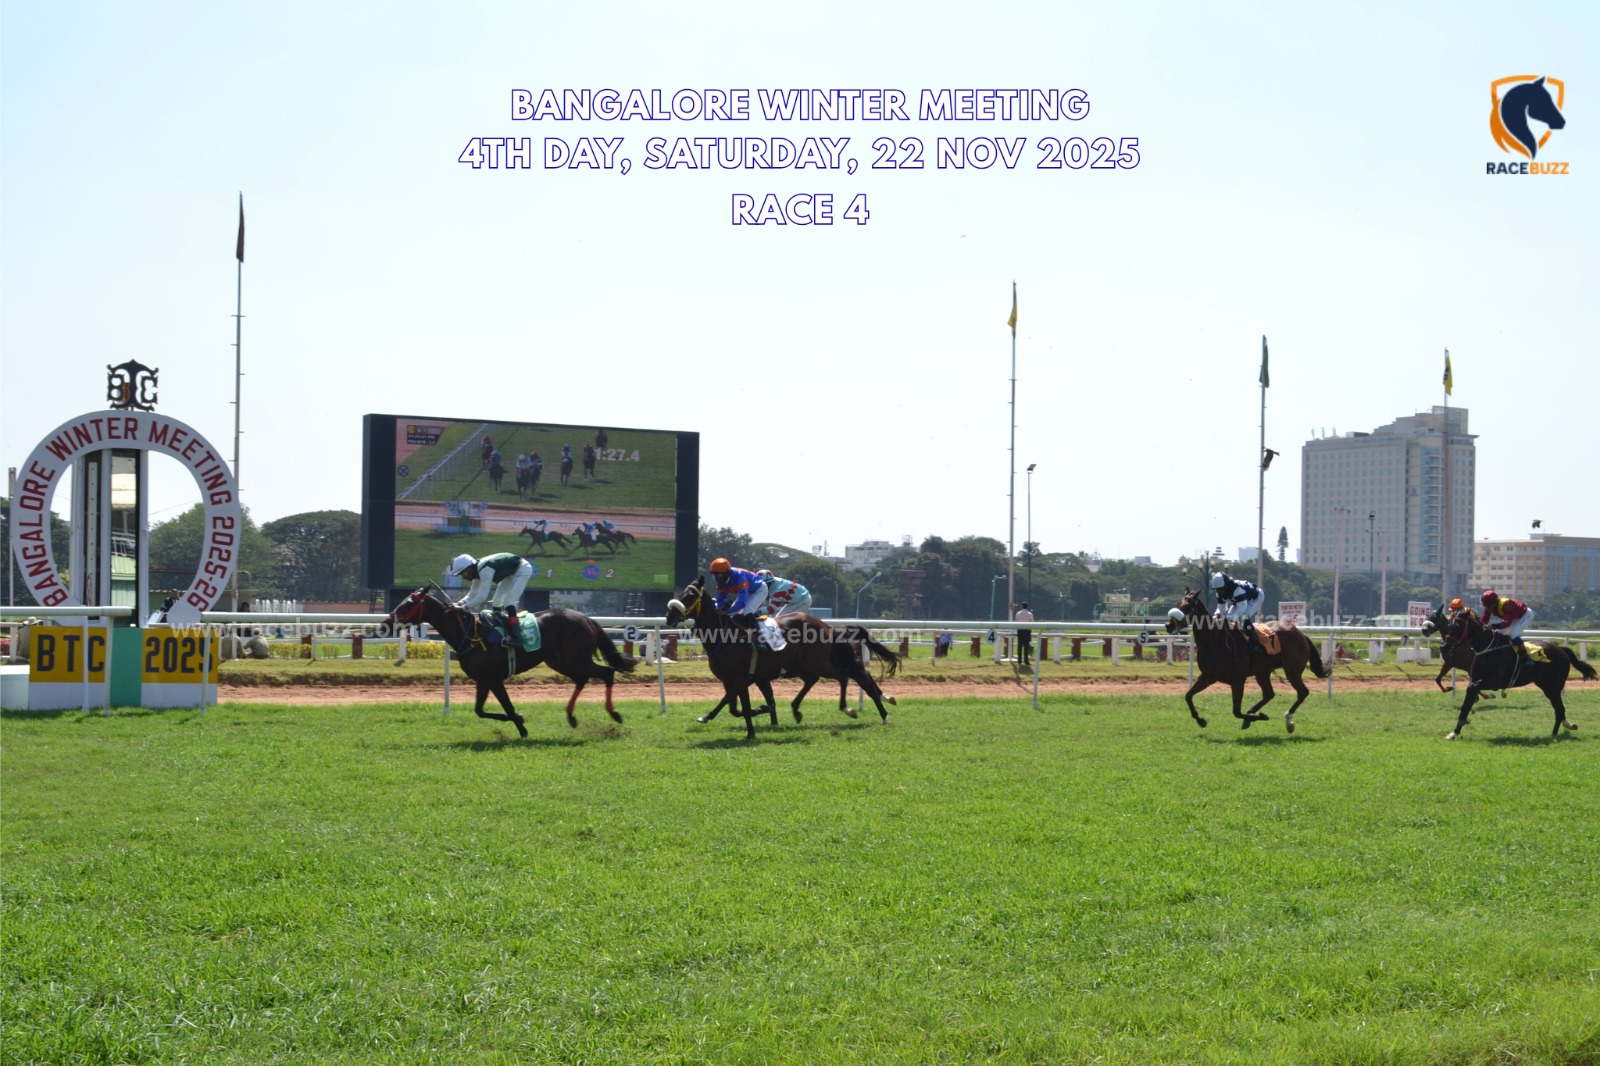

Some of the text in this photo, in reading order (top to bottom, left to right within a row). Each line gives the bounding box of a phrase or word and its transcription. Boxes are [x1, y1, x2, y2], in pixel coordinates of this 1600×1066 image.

[593, 446, 641, 462] 1:27.4
[18, 417, 235, 613] BANGALORE WINTER MEETING 2025-26
[605, 568, 615, 578] 2
[1410, 606, 1430, 617] GOING
[627, 626, 636, 640] 2
[987, 631, 996, 643] 4
[1140, 632, 1146, 644] 5
[1402, 635, 1409, 646] 7
[36, 633, 106, 673] BTC
[145, 635, 213, 674] 2025
